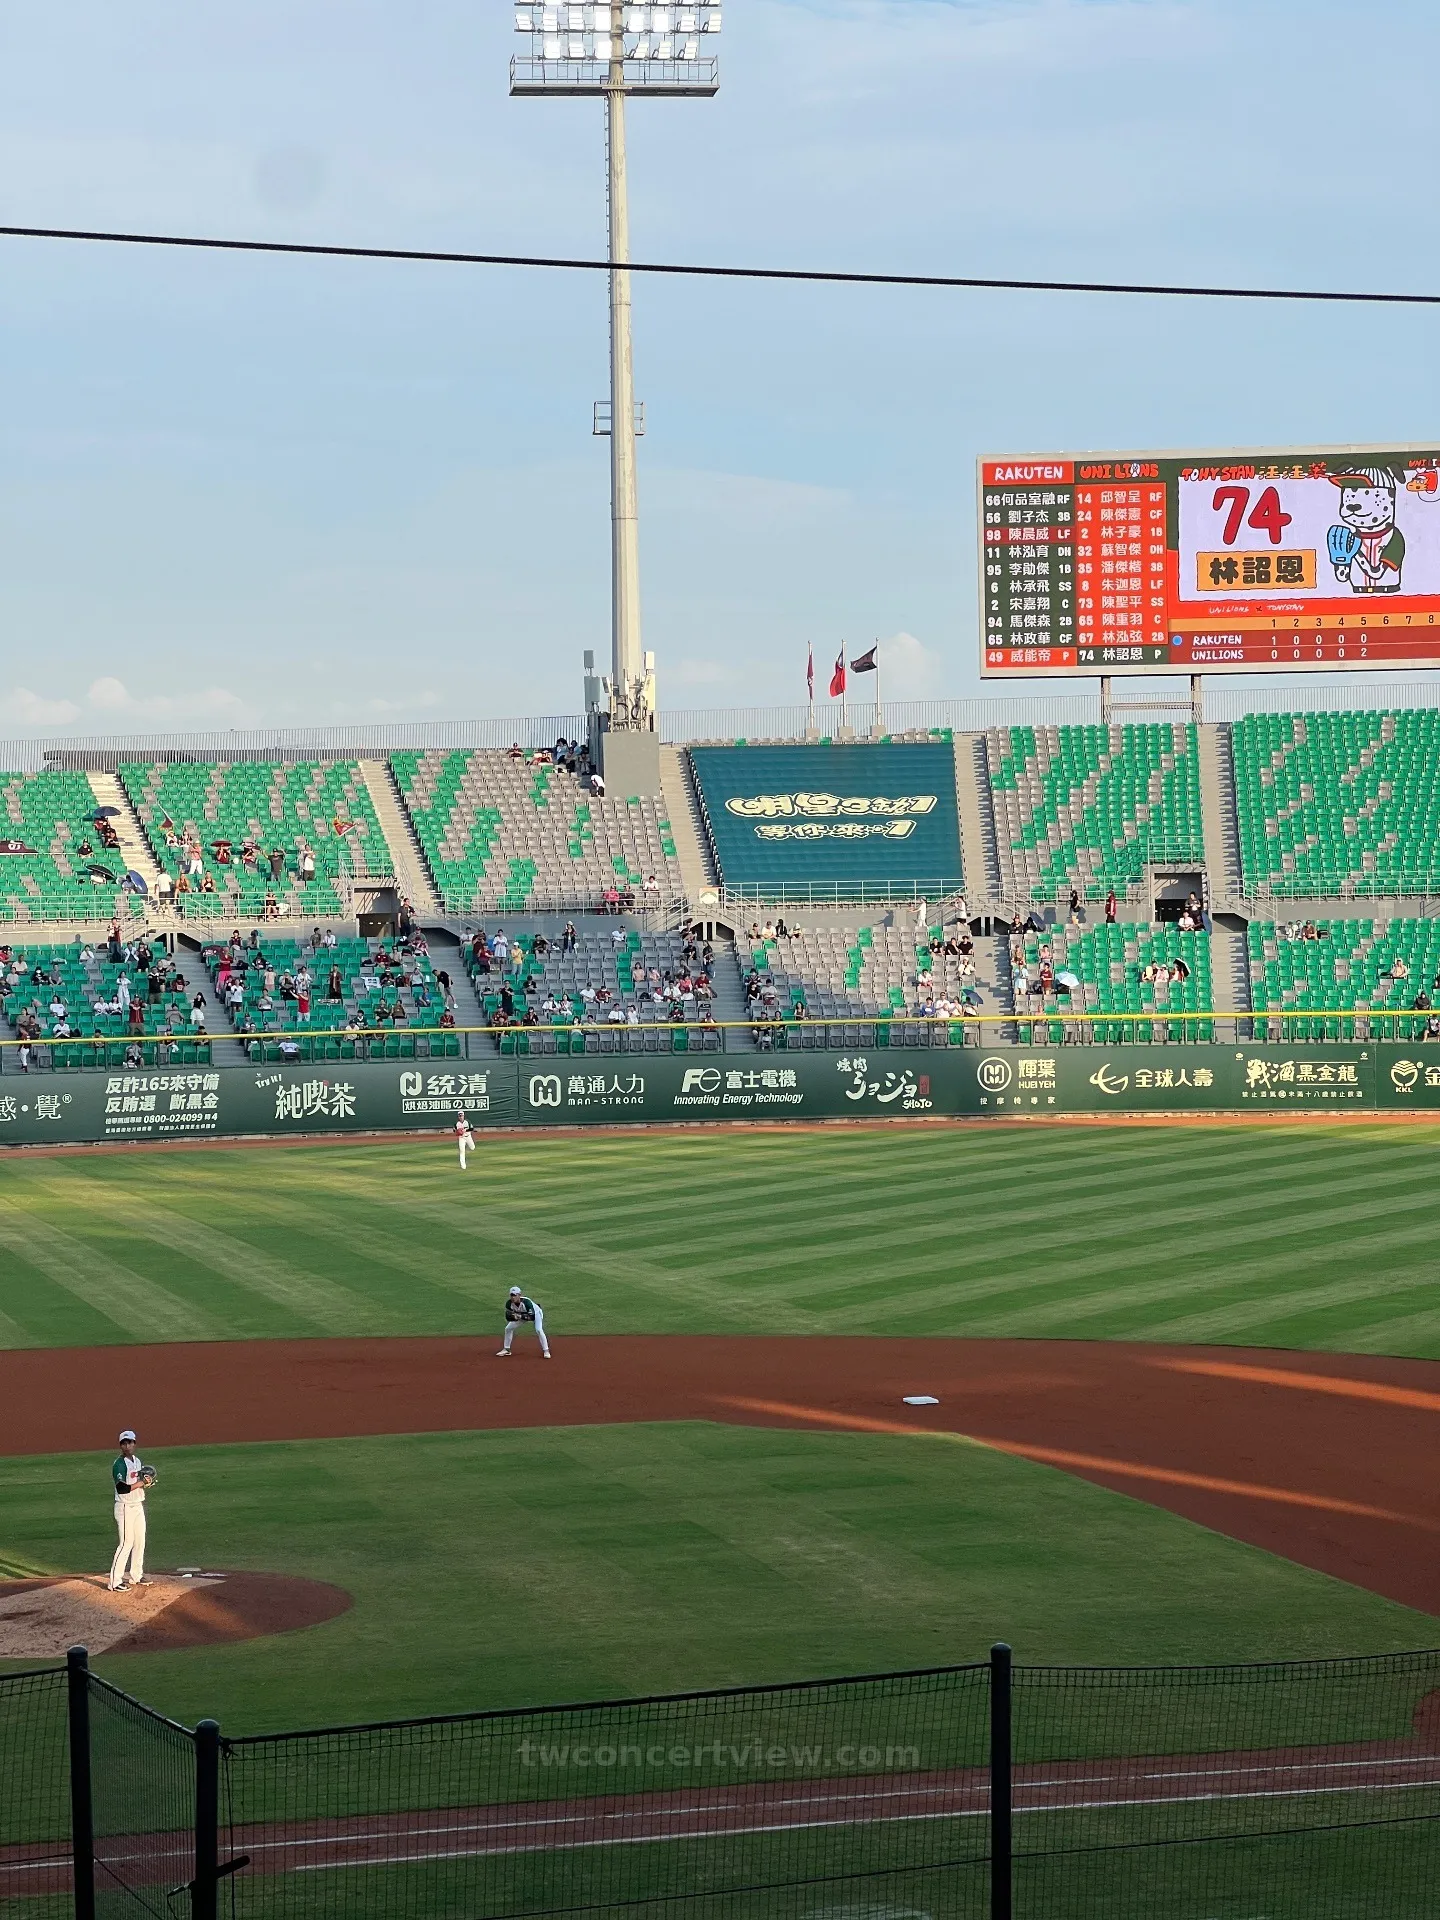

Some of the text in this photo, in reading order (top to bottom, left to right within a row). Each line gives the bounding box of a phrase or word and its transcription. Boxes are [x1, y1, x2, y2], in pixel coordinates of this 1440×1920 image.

[994, 466, 1063, 481] RAKUTEN
[1079, 463, 1159, 479] UNI LIONS
[1181, 467, 1220, 482] TONY
[1220, 464, 1255, 481] STAN
[985, 492, 1070, 506] 66 何品室融 RF
[1077, 490, 1162, 504] 14 邱智呈 RF
[986, 510, 1071, 524] 56 劉子杰 3B
[1077, 510, 1092, 521] 24
[1150, 509, 1163, 519] CF
[1212, 485, 1292, 545] 74
[986, 527, 1071, 541] 98 陳晨威 LF
[1081, 525, 1163, 539] 2 林子豪 1B
[987, 545, 1071, 558] 11 林泓育 DH
[1077, 543, 1164, 557] 32 蘇智傑 DH
[986, 564, 1002, 576] 95
[1058, 564, 1072, 574] 1B
[1078, 563, 1093, 574] 35
[1150, 562, 1164, 572] 3B
[1209, 556, 1305, 585] 林詔恩
[990, 580, 1072, 593] 6 林承飛 SS
[1081, 577, 1164, 591] 8 朱迦恩 LF
[991, 597, 1069, 611] 2 宋嘉翔 C
[1078, 595, 1164, 609] 73 陳聖平 SS
[987, 614, 1072, 628] 94 馬傑森 2B
[1079, 613, 1161, 626] 65 陳重羽 C
[1271, 614, 1434, 627] 1 2 3 4 5 6 7 8
[988, 632, 1073, 645] 65 林政華 CF
[1079, 630, 1164, 644] 67 林泓弦 2B
[1192, 633, 1367, 646] RAKUTEN 1 0 0 0 0
[988, 649, 1069, 663] 49 威能帝 P
[1079, 647, 1162, 661] 74 林詔恩 P
[1191, 647, 1367, 660] UNILIONS 0 0 0 0 2
[1018, 1059, 1056, 1079] 輝葉
[105, 1073, 220, 1094] 反詐165來守備
[567, 1073, 644, 1095] 萬通人力
[725, 1069, 797, 1089] 富士電機
[1018, 1080, 1055, 1089] HUEI YEH
[1135, 1068, 1214, 1088] 全球人壽
[104, 1092, 220, 1114] 反賄選 斷黑金
[275, 1080, 357, 1120] 純喫茶
[674, 1092, 804, 1106] Innovating Energy Technology
[902, 1098, 933, 1110] SHOJO
[143, 1113, 203, 1124] 0800-024099
